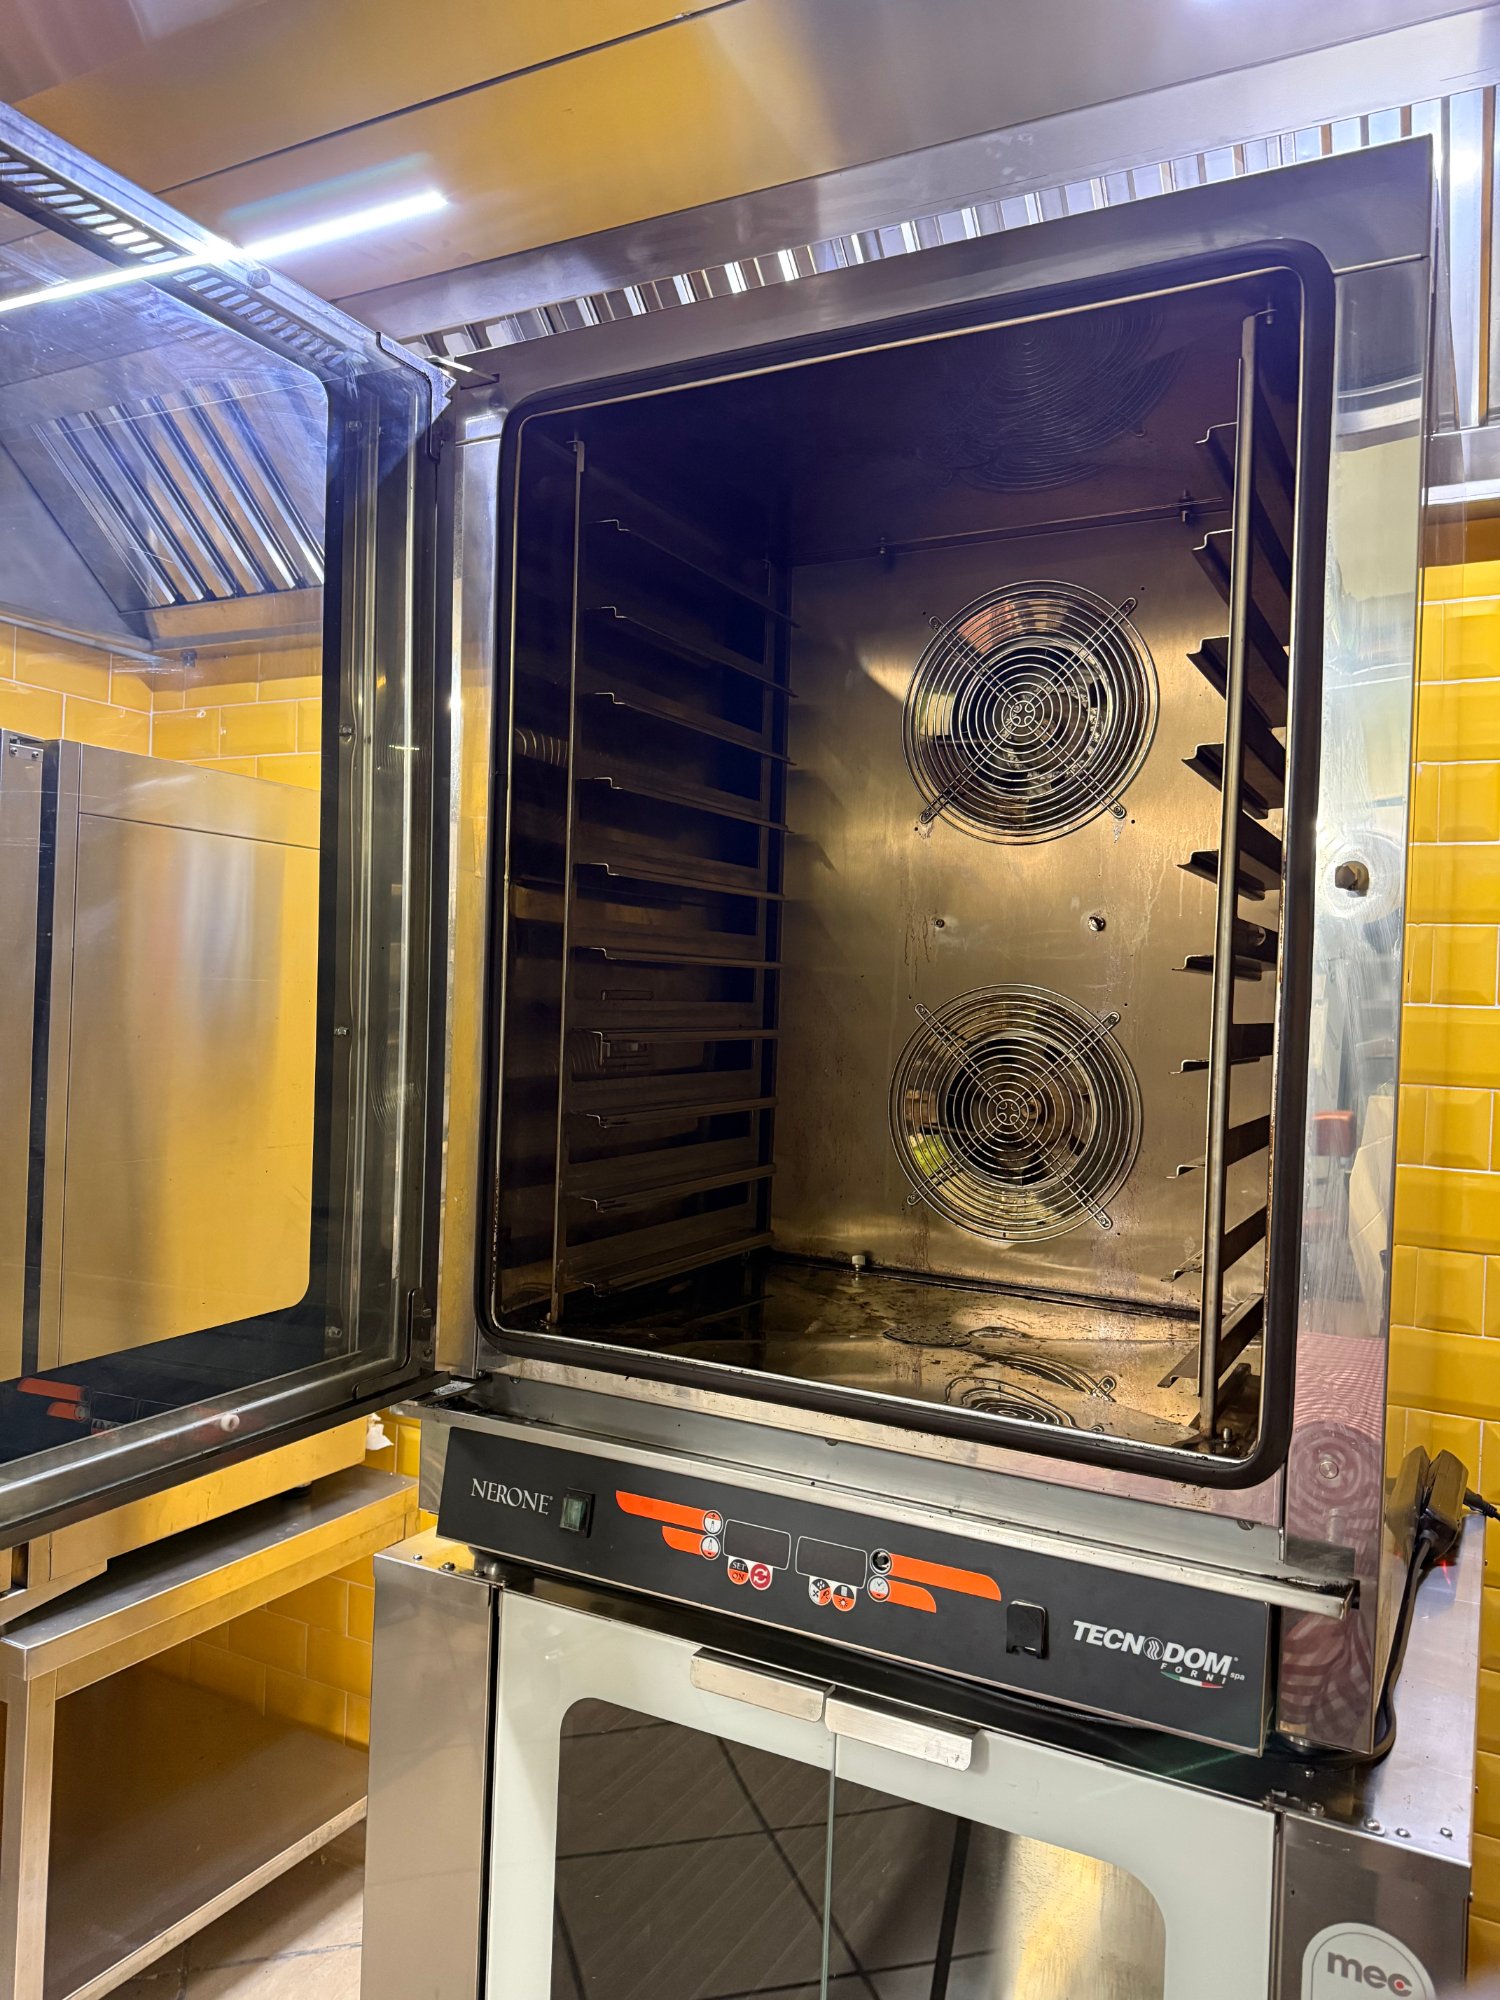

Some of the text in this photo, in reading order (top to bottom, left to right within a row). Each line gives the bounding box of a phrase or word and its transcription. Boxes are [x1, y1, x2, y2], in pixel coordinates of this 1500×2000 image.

[471, 1478, 550, 1515] NERONE
[732, 1561, 747, 1571] SET
[732, 1572, 745, 1581] ON
[1160, 1662, 1245, 1685] FORNI spa
[1327, 1951, 1412, 1997] mec
